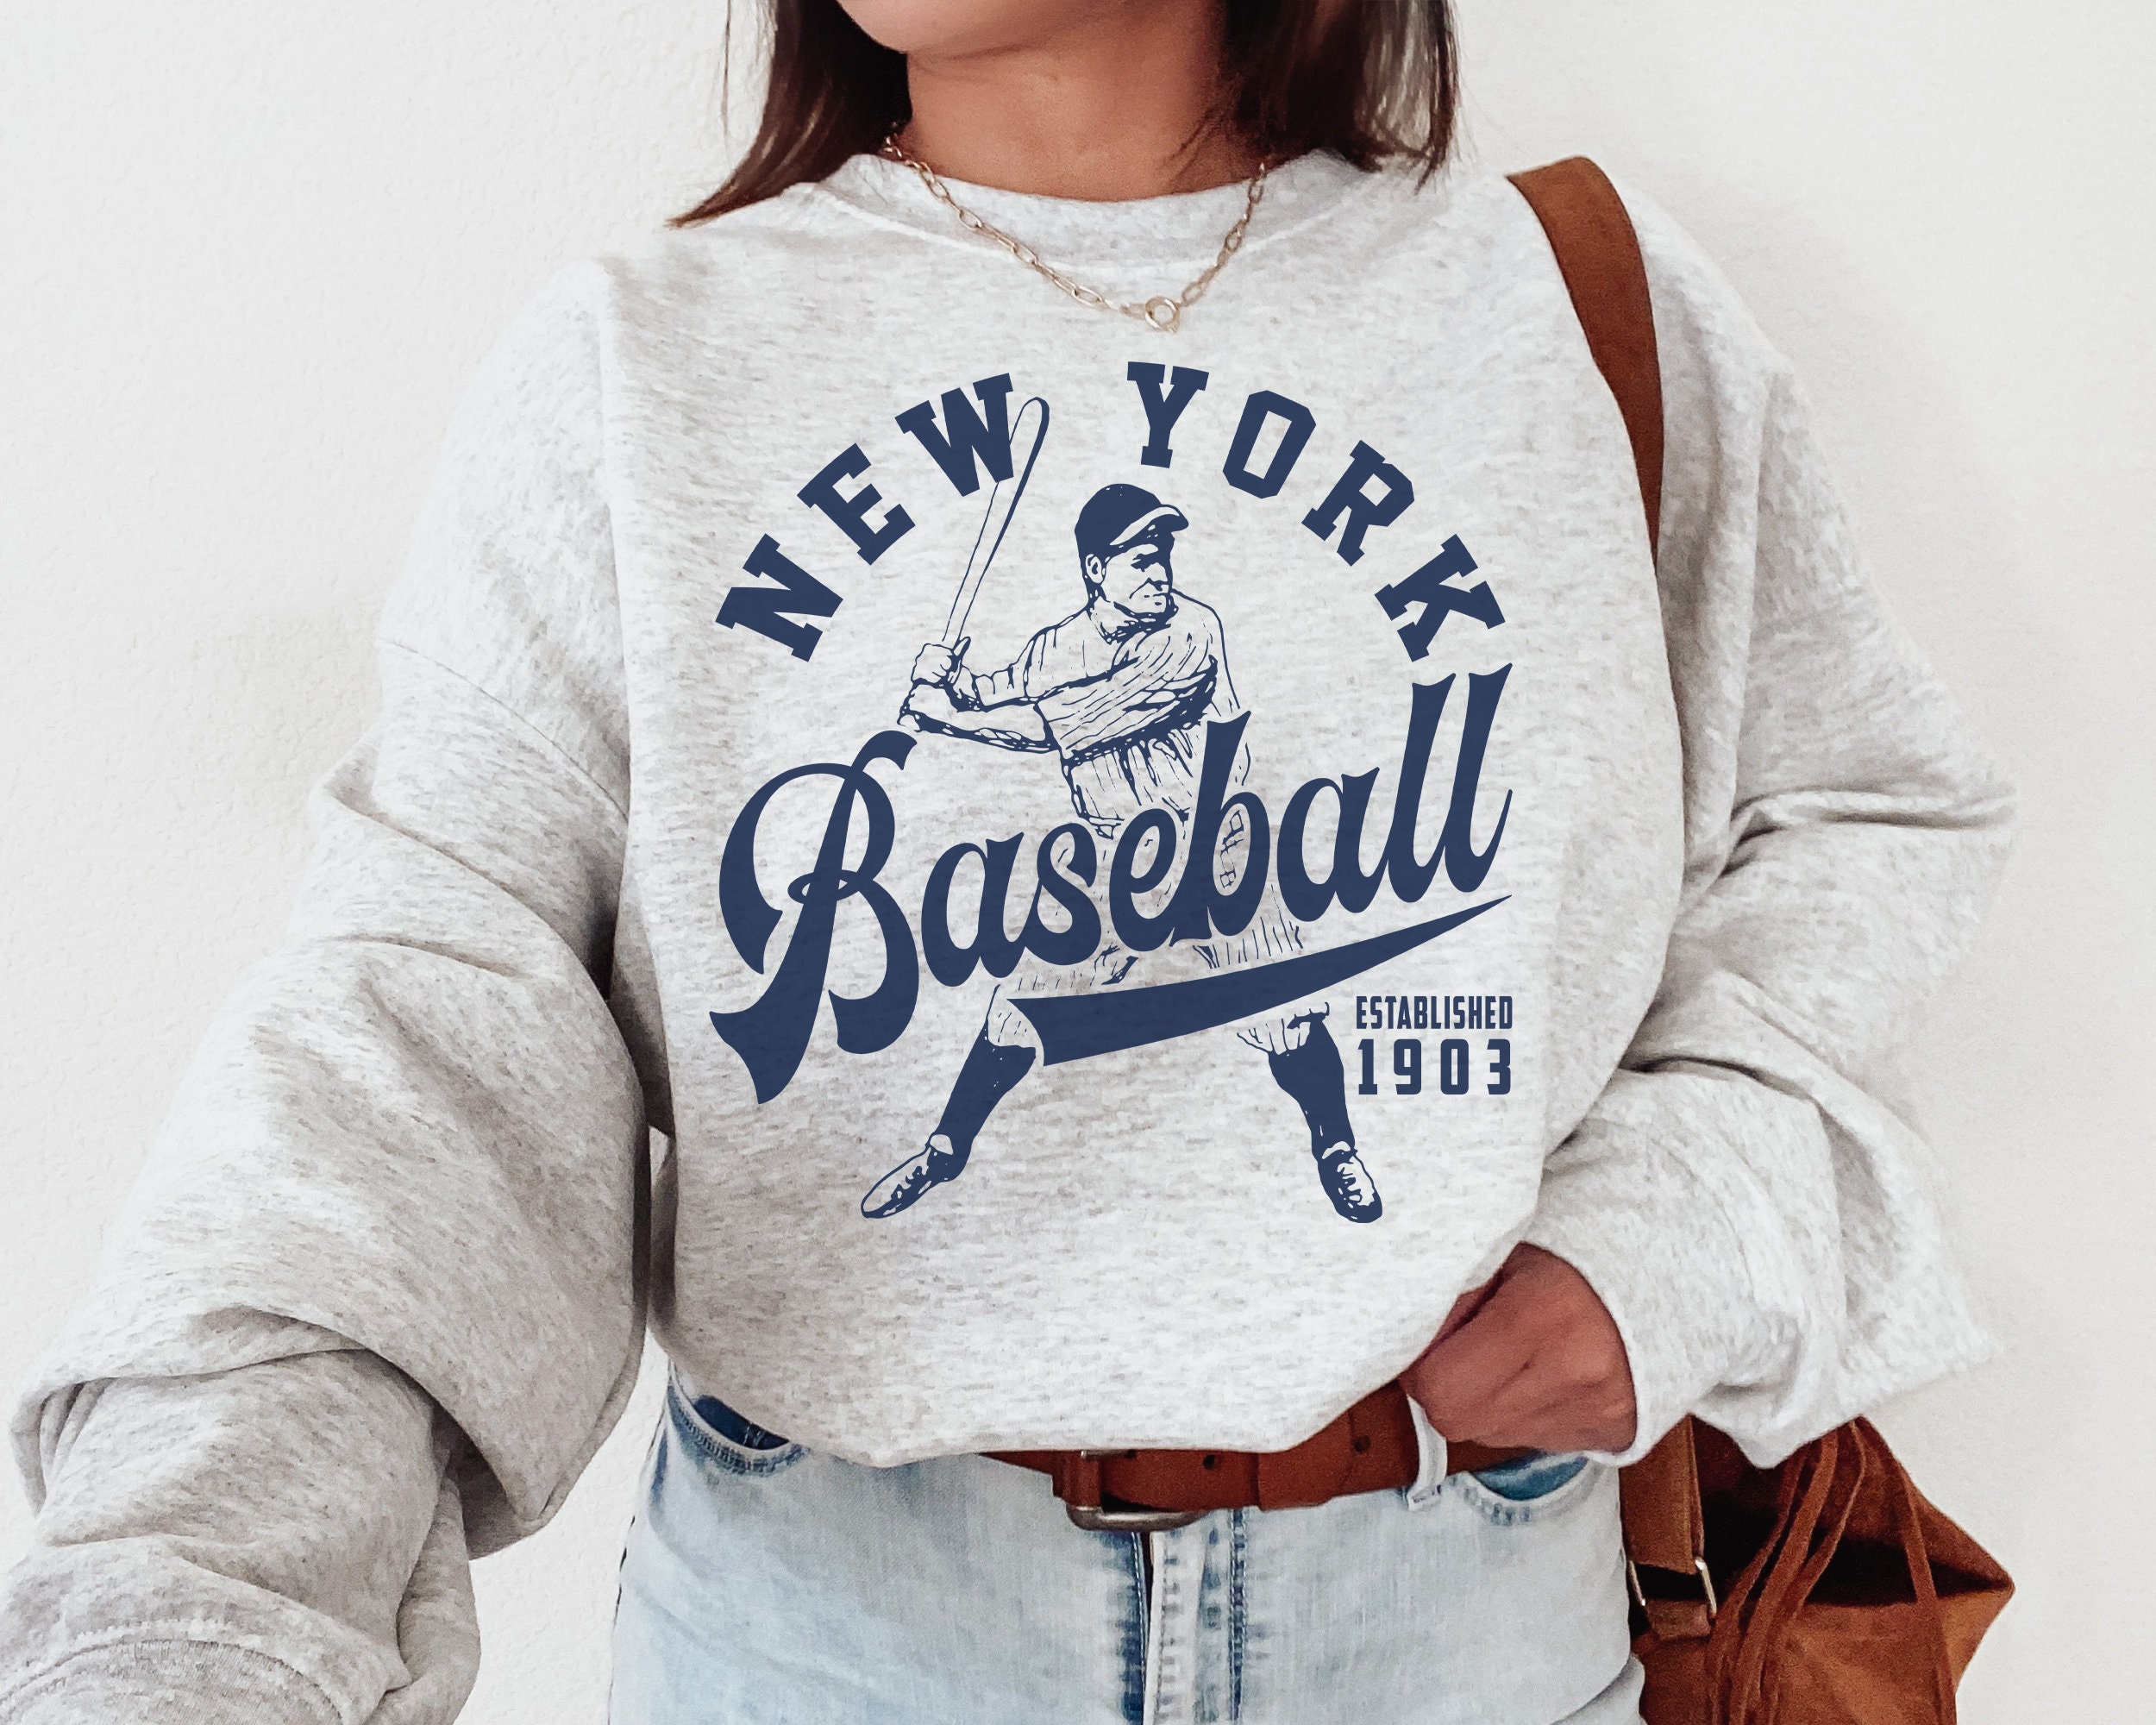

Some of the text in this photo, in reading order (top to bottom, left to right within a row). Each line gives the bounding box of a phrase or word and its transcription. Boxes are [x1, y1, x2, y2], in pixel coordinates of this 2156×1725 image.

[716, 361, 1504, 662] NEW YORK
[710, 663, 1513, 1104] Baseball
[1356, 995, 1514, 1030] ESTABLISHED
[1357, 1038, 1512, 1095] 1903
